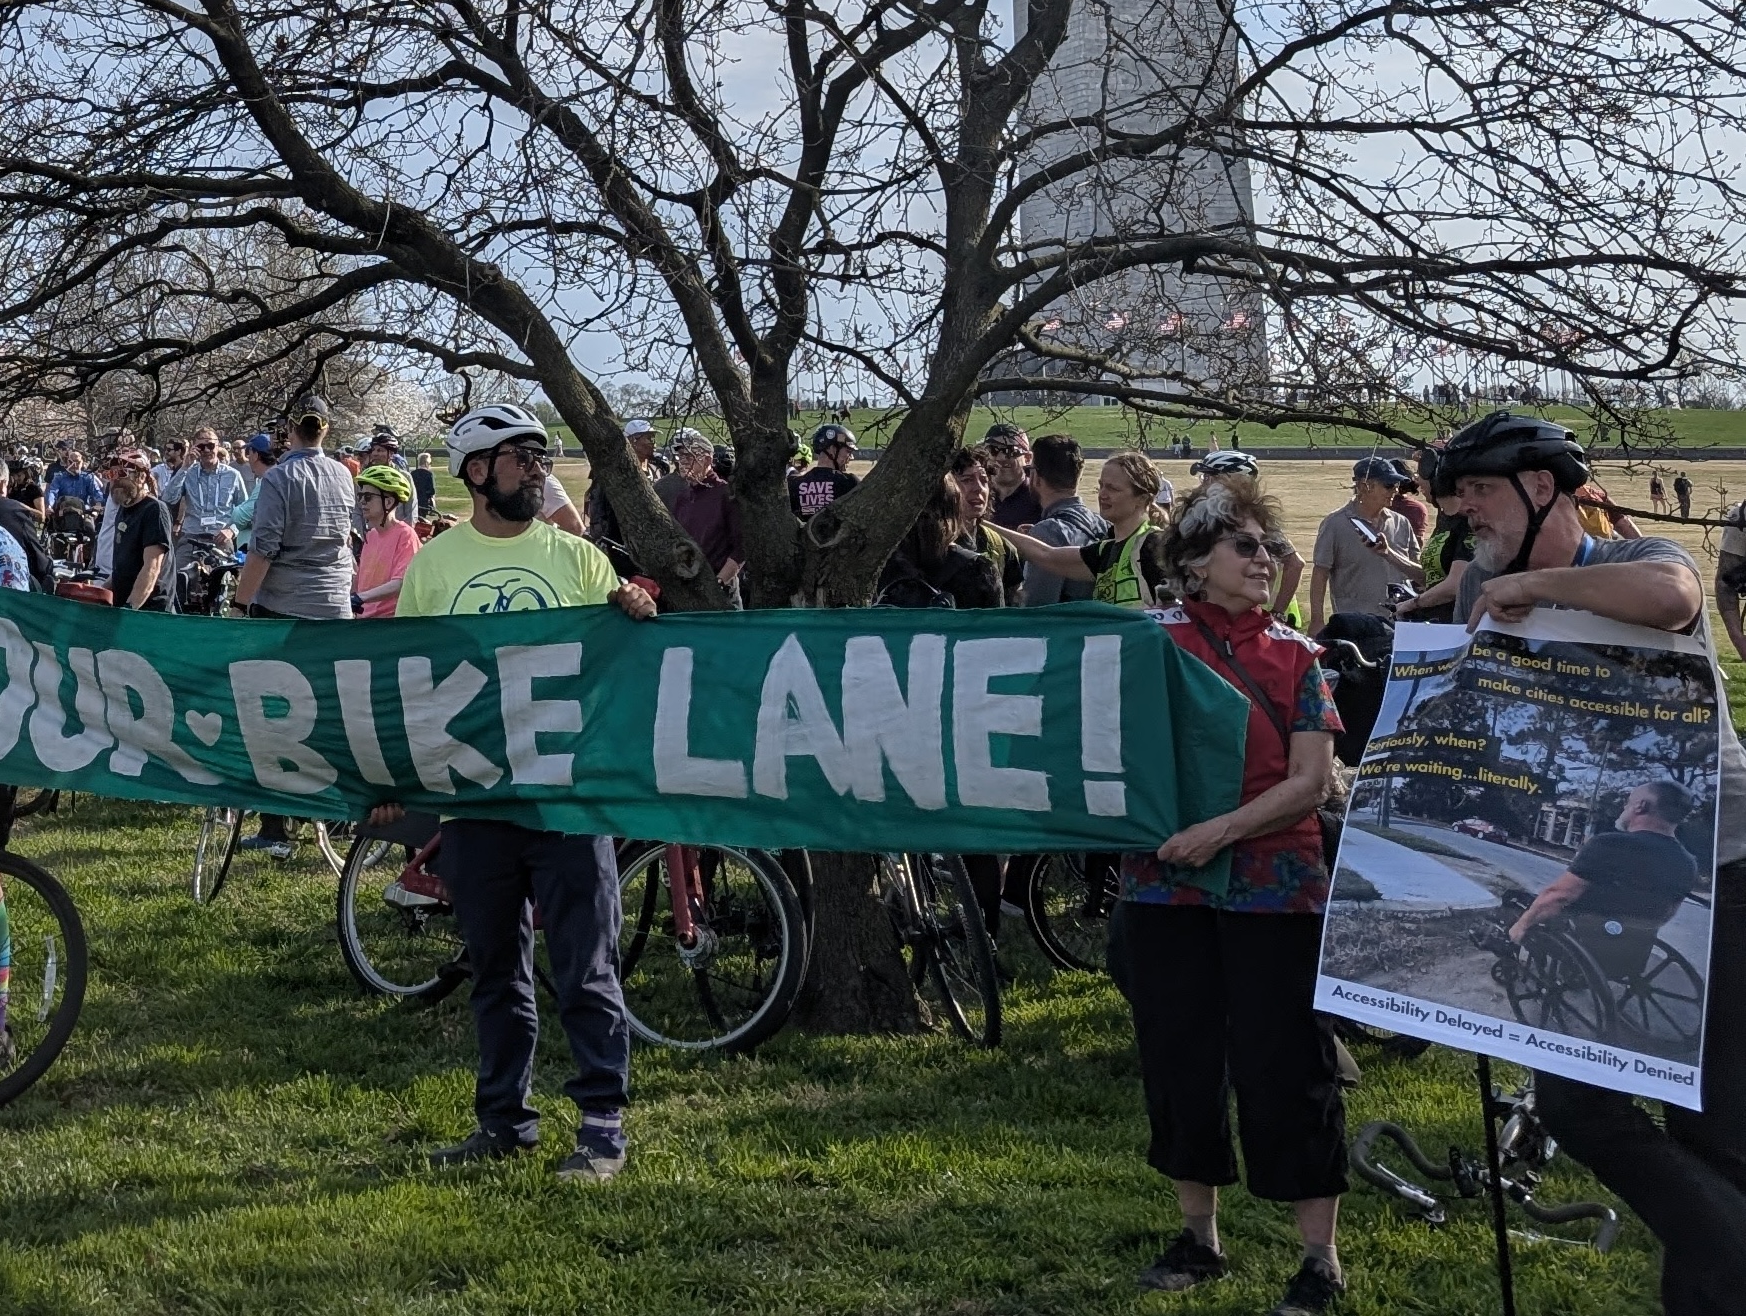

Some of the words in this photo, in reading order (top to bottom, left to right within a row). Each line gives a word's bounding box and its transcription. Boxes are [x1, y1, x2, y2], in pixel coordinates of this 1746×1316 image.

[798, 481, 834, 495] SAVE
[799, 494, 834, 506] LIVES
[1394, 665, 1433, 678] When
[1472, 643, 1491, 657] be
[1495, 651, 1506, 662] a
[1510, 655, 1552, 671] good
[1556, 660, 1591, 678] time
[1595, 664, 1611, 679] to
[1478, 677, 1521, 695] make
[1525, 686, 1565, 706] cities
[1569, 697, 1650, 719] accessible
[1654, 703, 1678, 722] for
[1681, 706, 1711, 725] all?
[228, 642, 583, 795] BIKE
[653, 632, 1127, 817] LANE!
[1366, 731, 1430, 753] Seriously,
[1434, 732, 1487, 751] when?
[1361, 762, 1401, 777] We're
[1331, 984, 1431, 1023] Accessibility
[1435, 1009, 1504, 1038] Delayed
[1508, 1032, 1521, 1042] =
[1525, 1033, 1629, 1073] Accessibility
[1633, 1059, 1695, 1087] Denied
